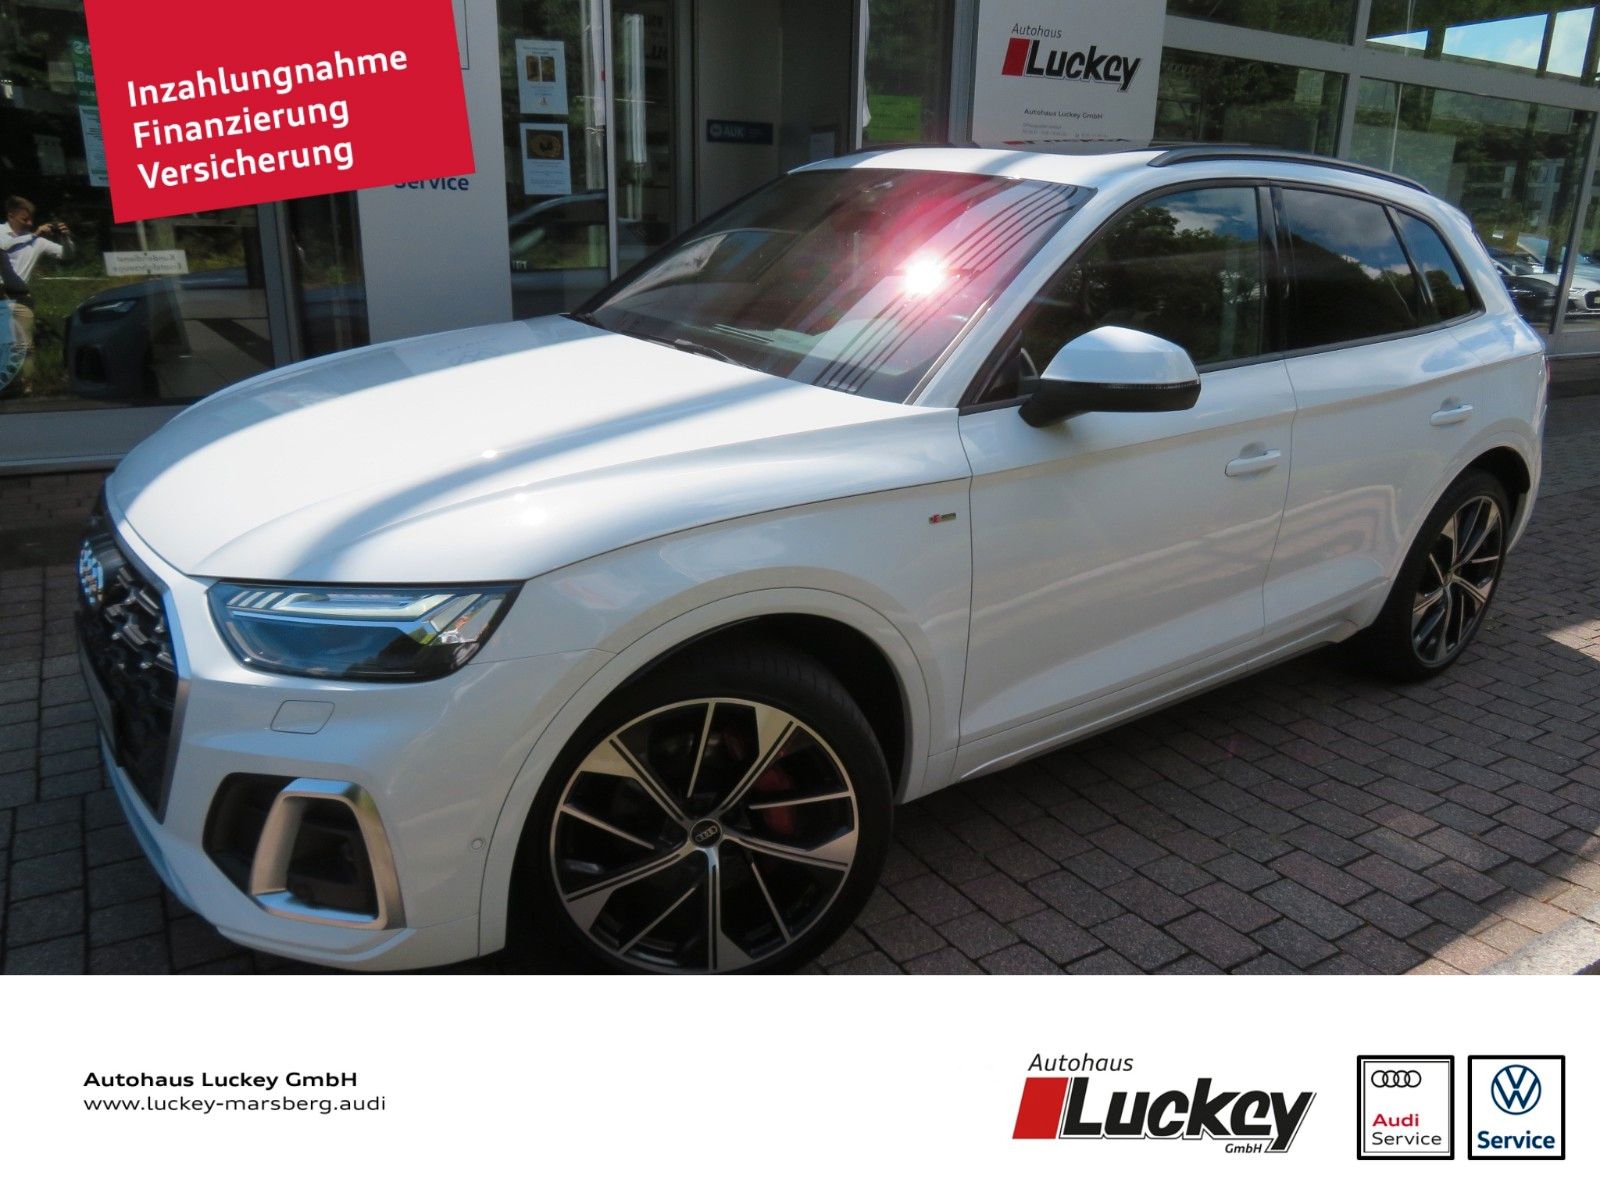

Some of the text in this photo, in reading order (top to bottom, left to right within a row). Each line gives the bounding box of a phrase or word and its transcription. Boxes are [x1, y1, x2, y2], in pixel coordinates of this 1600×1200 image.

[1011, 23, 1062, 39] Autohaus
[1026, 39, 1142, 92] Luckey
[1024, 108, 1103, 120] Autohaus Luckey GmbH
